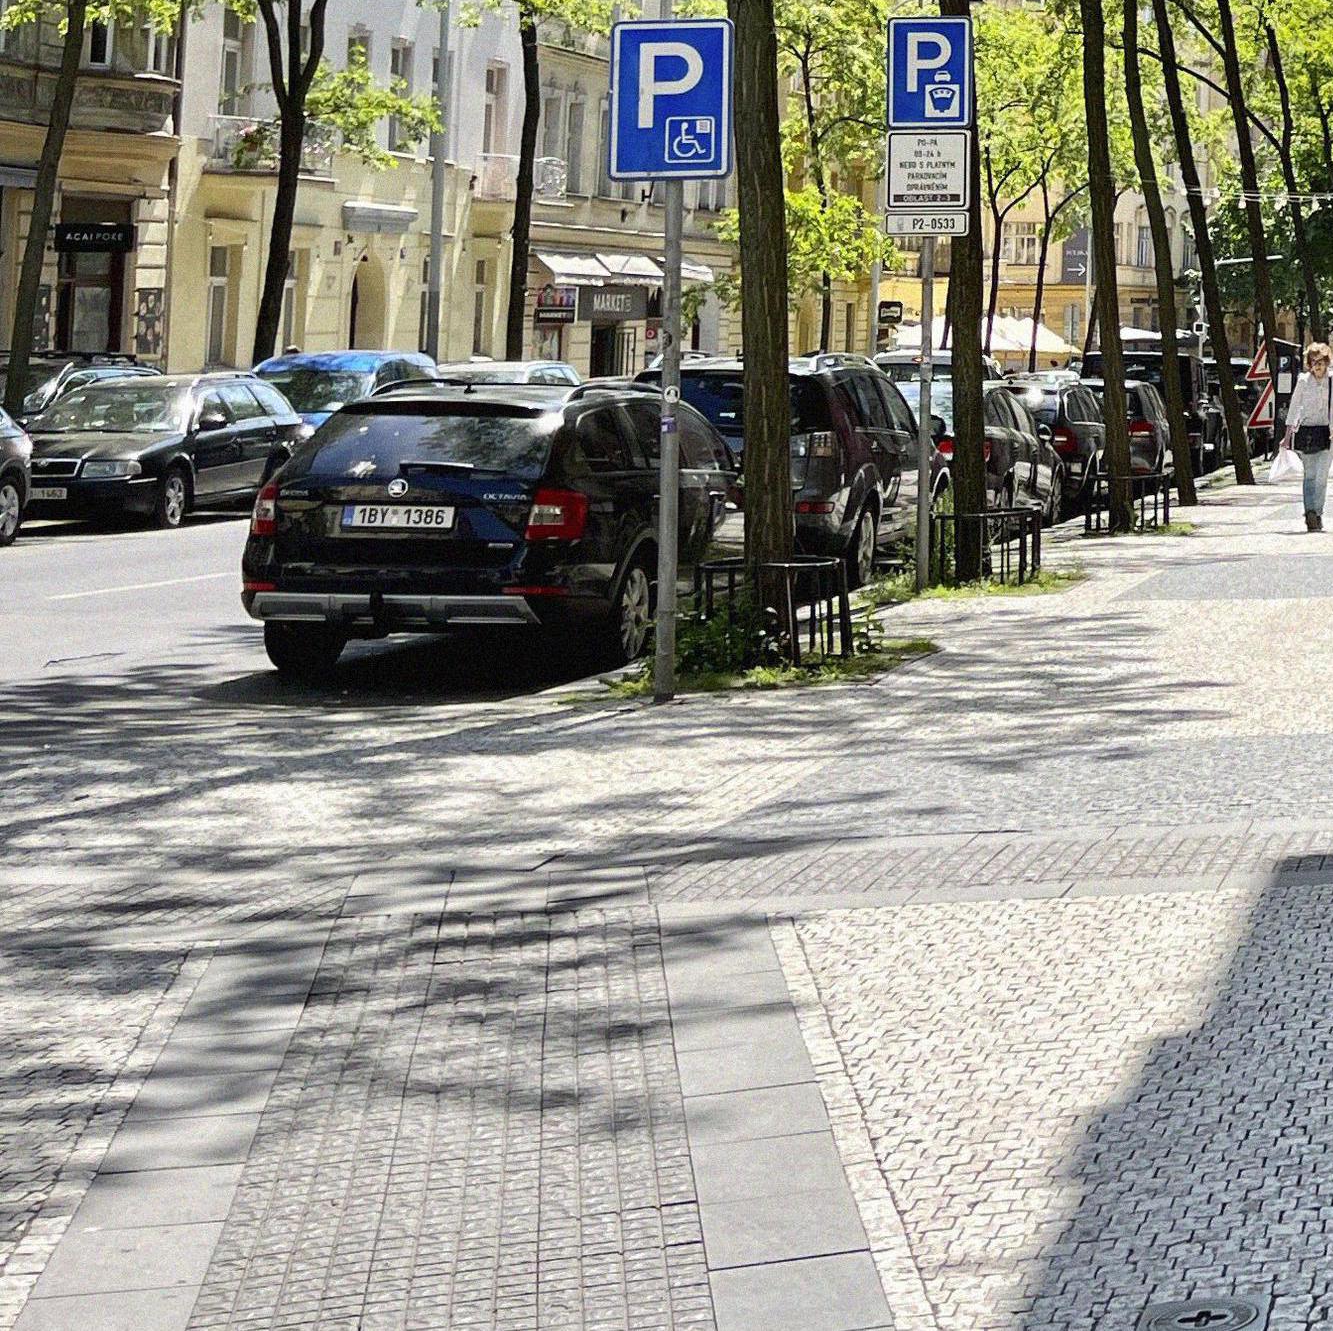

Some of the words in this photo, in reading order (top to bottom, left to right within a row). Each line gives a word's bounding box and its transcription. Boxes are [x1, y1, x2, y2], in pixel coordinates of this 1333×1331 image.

[906, 31, 952, 92] P
[638, 41, 704, 129] P
[912, 217, 956, 230] P2-0533
[593, 293, 625, 312] MARKET
[482, 492, 528, 501] OCTAVIA
[359, 507, 390, 525] 1BY
[402, 508, 446, 525] 1386
